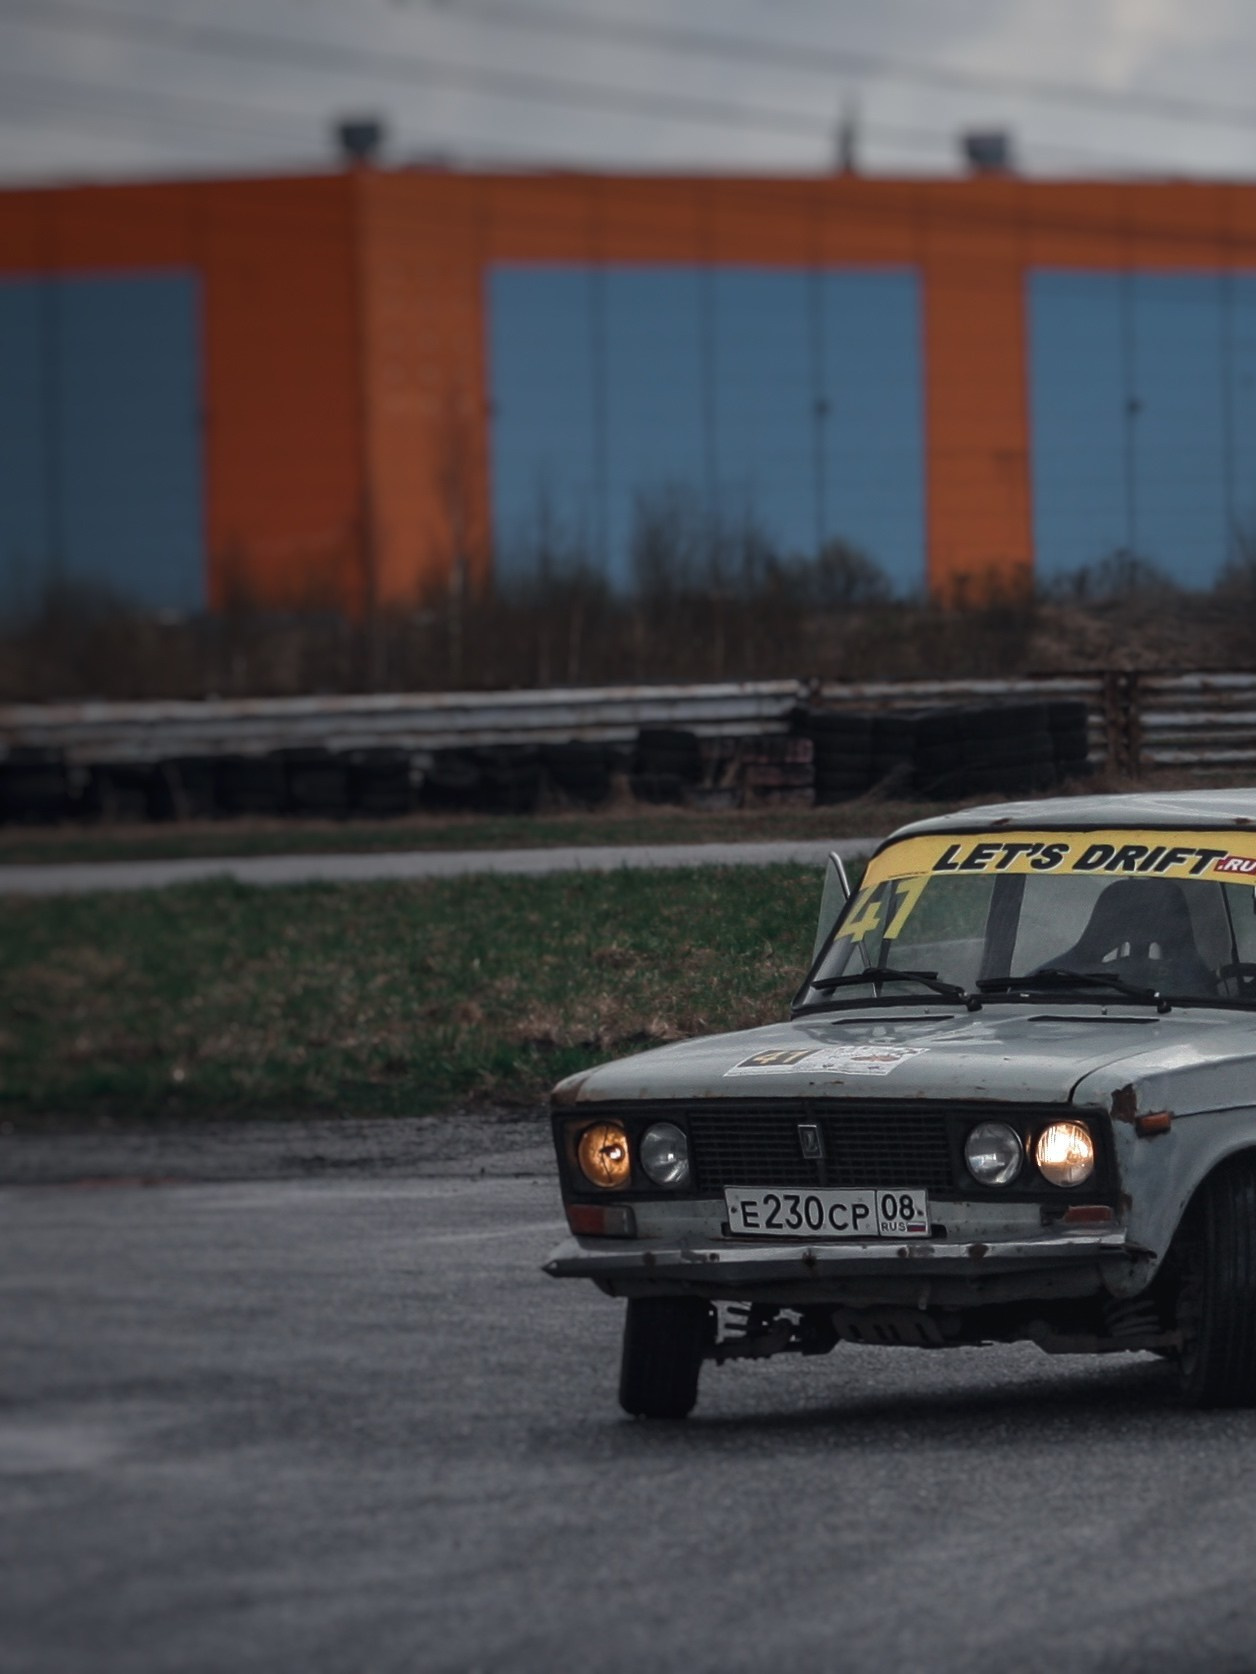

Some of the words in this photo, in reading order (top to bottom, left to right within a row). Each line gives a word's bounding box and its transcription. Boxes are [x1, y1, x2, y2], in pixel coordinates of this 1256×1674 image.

[932, 843, 1070, 873] LET'S
[1072, 844, 1229, 876] DRIFT
[740, 1194, 870, 1231] E230CP
[881, 1194, 915, 1221] 08
[881, 1222, 907, 1232] RUS
